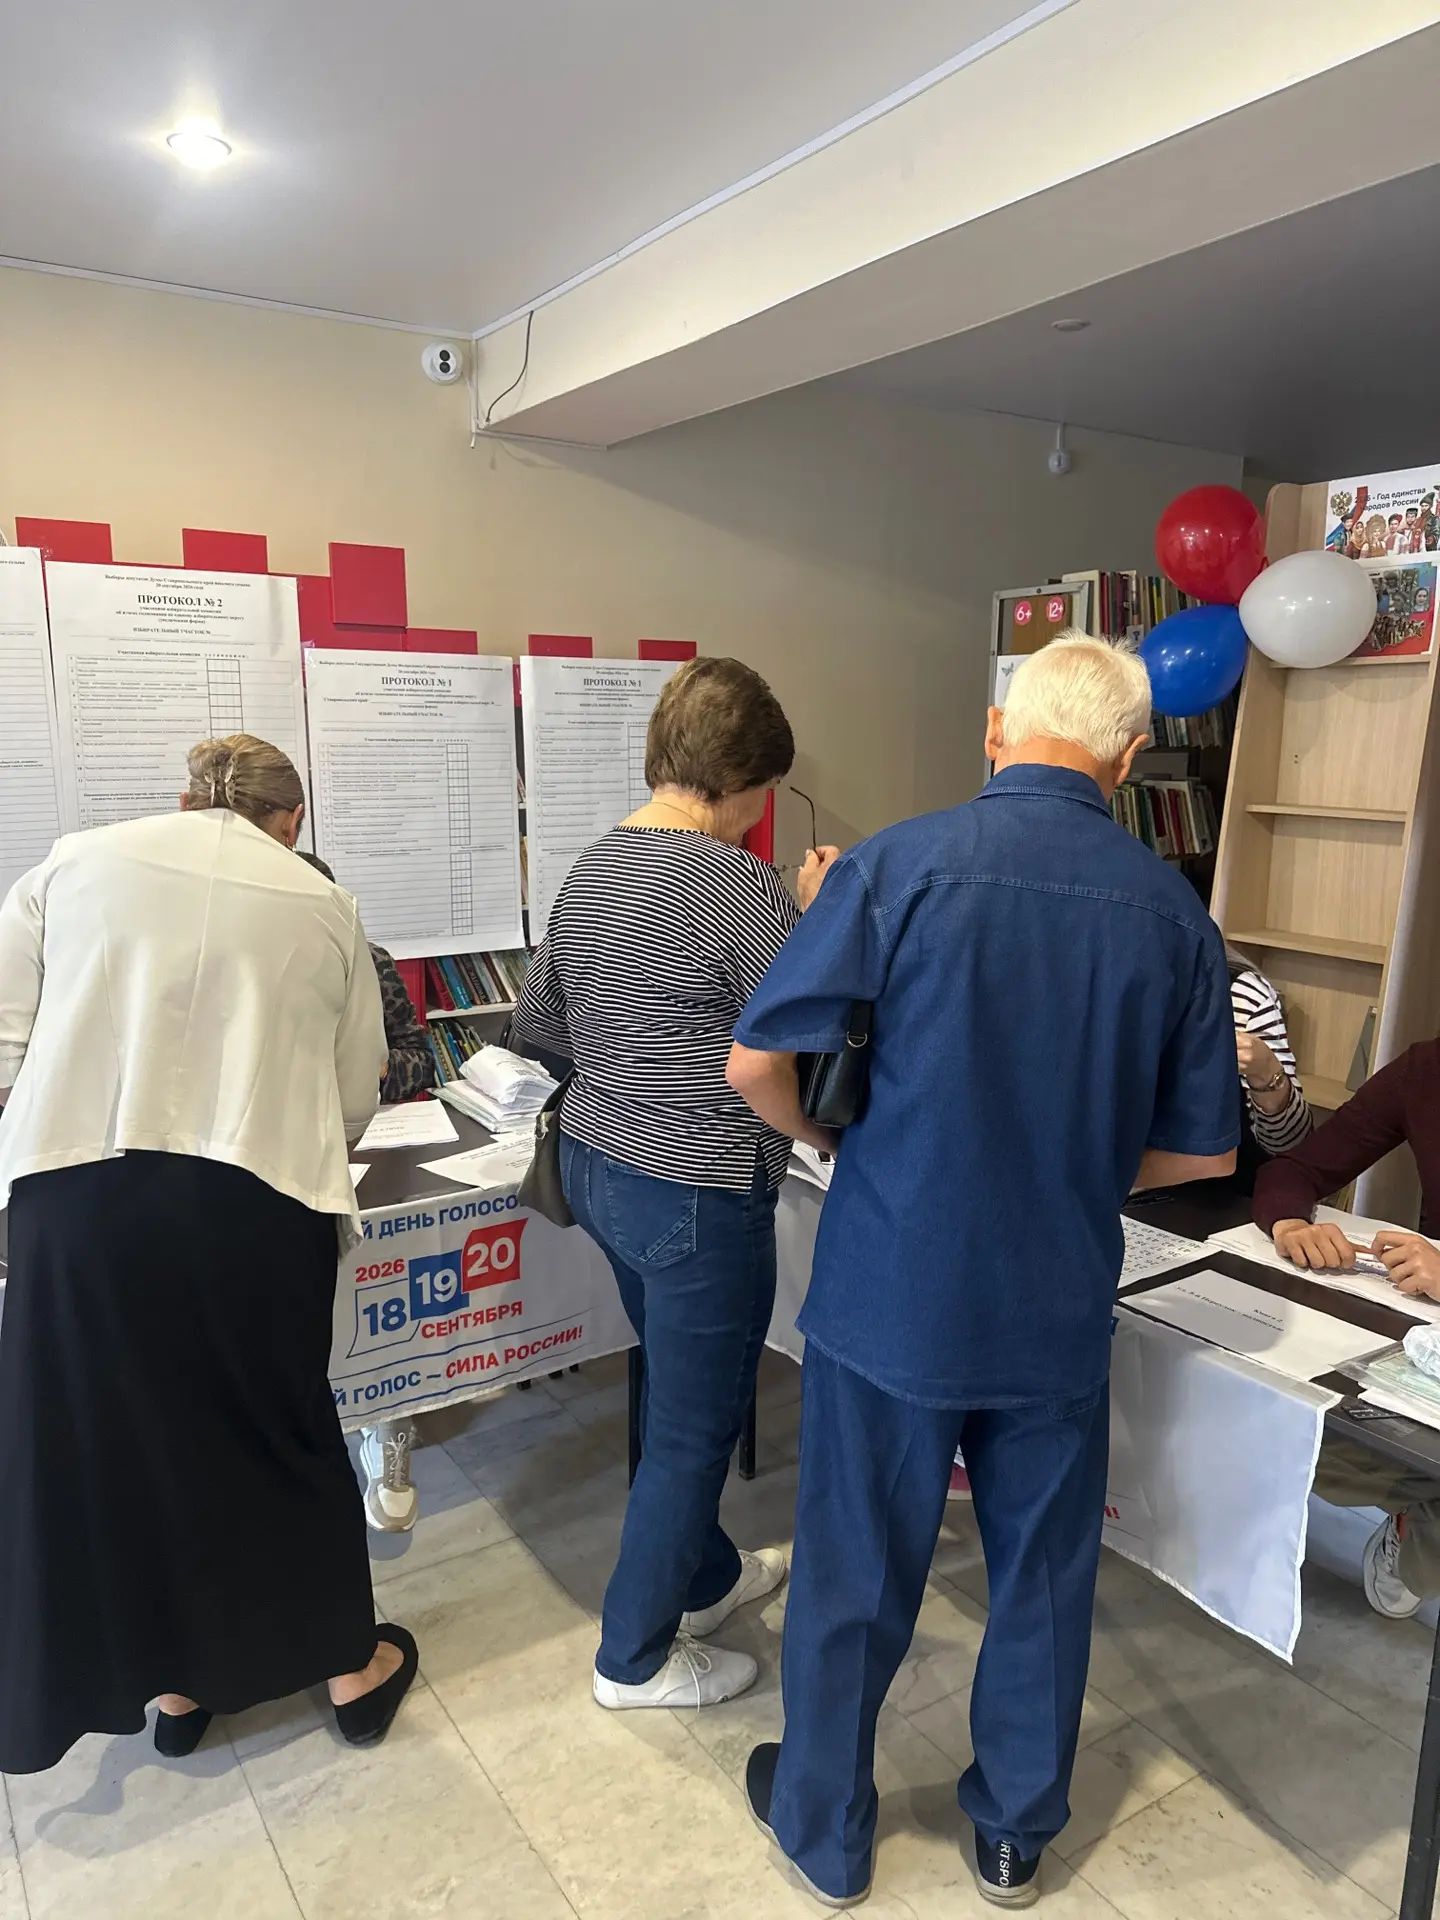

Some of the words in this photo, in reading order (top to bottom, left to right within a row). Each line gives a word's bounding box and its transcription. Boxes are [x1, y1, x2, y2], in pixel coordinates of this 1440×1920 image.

[1377, 492, 1390, 501] Год
[1391, 487, 1426, 498] единства
[1392, 498, 1419, 507] России
[138, 594, 201, 606] ПРОТОКОЛ
[204, 597, 215, 607] №
[217, 598, 223, 607] 2
[1048, 602, 1064, 618] 12+
[1015, 606, 1032, 621] 6+
[381, 676, 435, 686] ПРОТОКОЛ
[583, 678, 627, 687] ПРОТОКОЛ
[378, 1213, 435, 1240] ДЕНЬ
[439, 1194, 521, 1225] ГОЛОСО
[466, 1237, 516, 1278] 20
[355, 1258, 406, 1283] 2026
[415, 1268, 458, 1305] 19
[363, 1298, 408, 1336] 18
[421, 1300, 523, 1339] СЕНТЯБРЯ
[353, 1371, 422, 1405] ГОЛОС
[445, 1352, 500, 1379] СИЛА
[504, 1325, 583, 1365] РОССИИ!
[999, 1840, 1011, 1887] RTSPO
